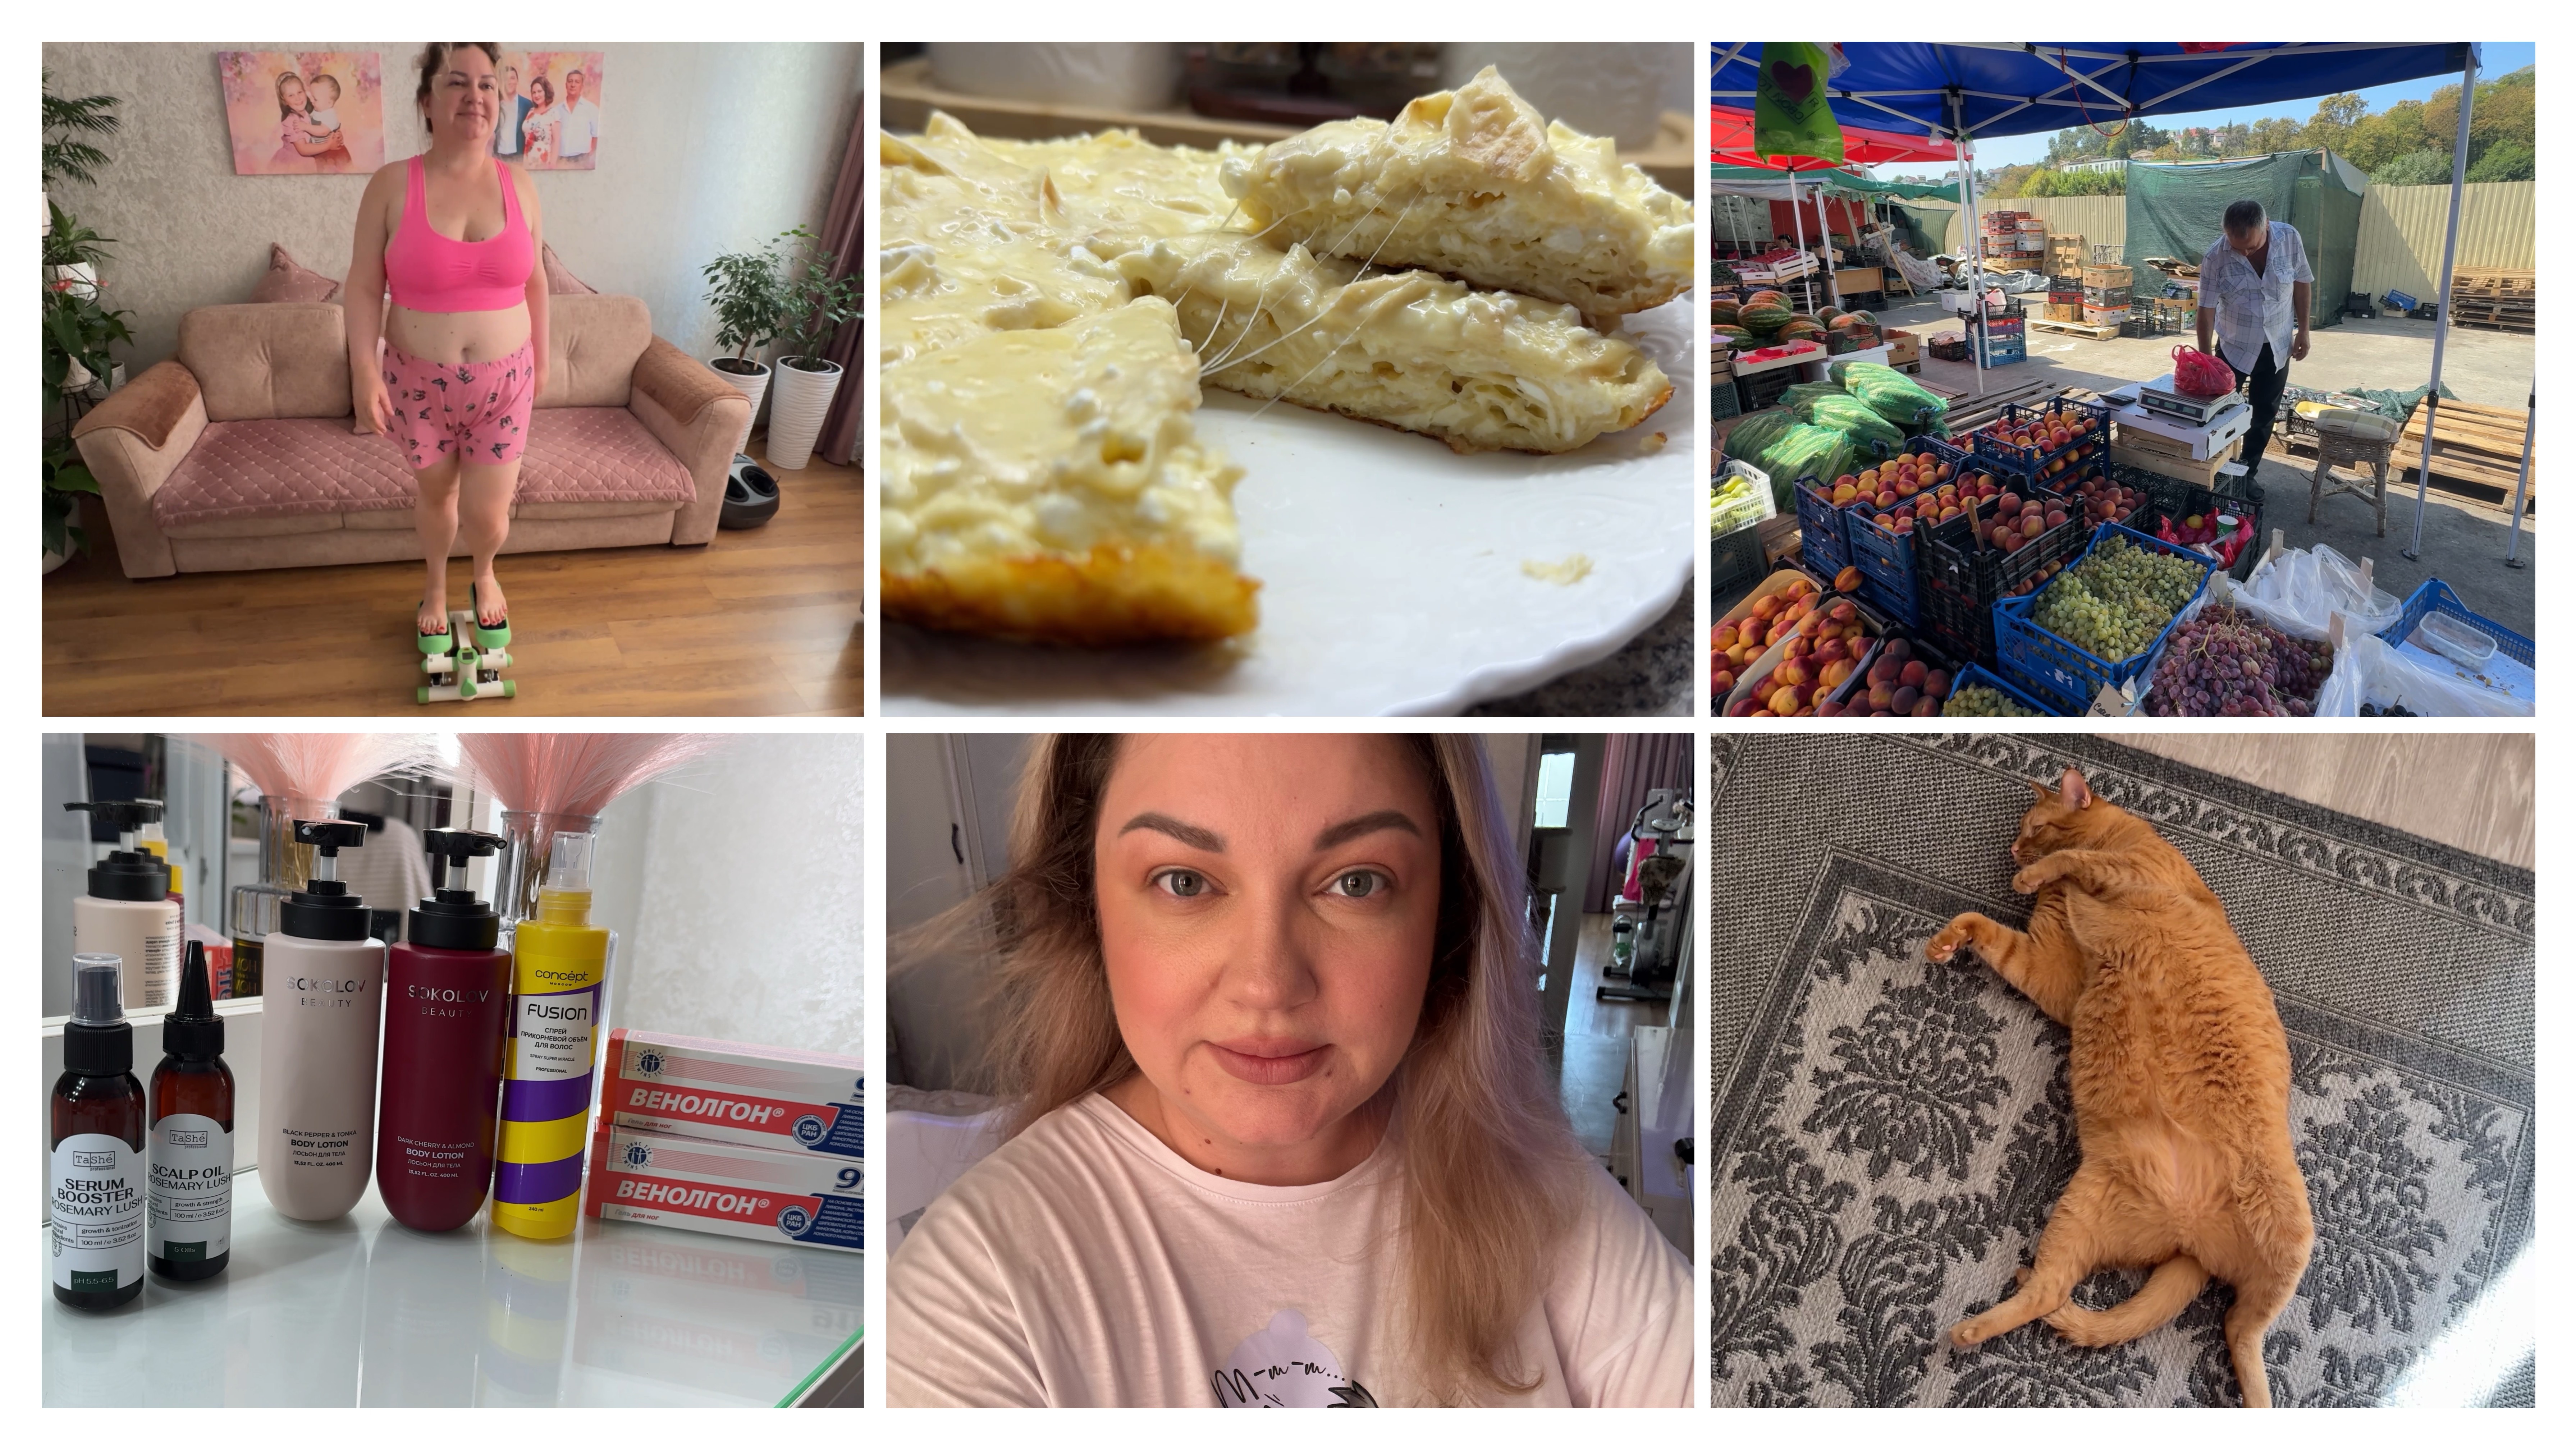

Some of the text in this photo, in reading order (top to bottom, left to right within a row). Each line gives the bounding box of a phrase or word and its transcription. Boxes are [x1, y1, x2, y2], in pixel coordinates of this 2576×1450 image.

[287, 976, 366, 993] SOKOLOV
[408, 985, 489, 1002] SOKOLOV
[302, 998, 351, 1007] BEAUTY
[422, 1006, 472, 1018] BEAUTY
[521, 1031, 567, 1042] ПРИКОРНЕВОЙ
[635, 1064, 651, 1078] TWINS
[172, 1133, 205, 1142] TaShé
[283, 1128, 303, 1137] BLACK
[291, 1139, 316, 1148] BODY
[398, 1136, 413, 1145] DARK
[76, 1153, 113, 1164] TaShé
[406, 1148, 430, 1157] BODY
[407, 1159, 431, 1167] ЛОСЬОН
[622, 1156, 637, 1170] TWINS
[152, 1163, 225, 1179] SCALP OIL
[65, 1177, 124, 1192] SERUM
[148, 1171, 230, 1190] ROSEMARY LUSH
[58, 1187, 133, 1204] BOOSTER
[203, 1197, 223, 1206] strength
[52, 1195, 143, 1216] ROSEMARY LUSH
[112, 1220, 137, 1232] tonization
